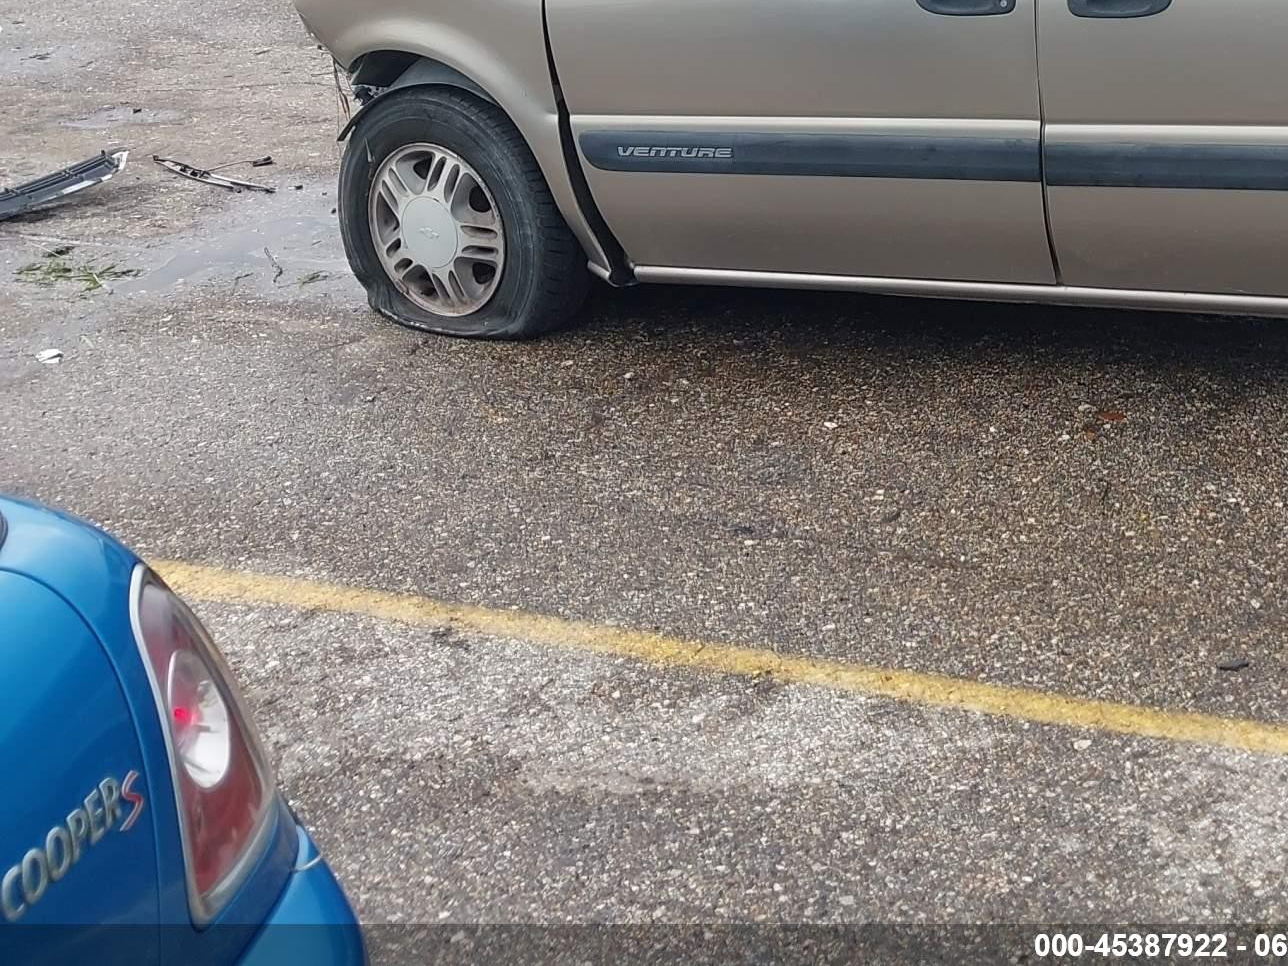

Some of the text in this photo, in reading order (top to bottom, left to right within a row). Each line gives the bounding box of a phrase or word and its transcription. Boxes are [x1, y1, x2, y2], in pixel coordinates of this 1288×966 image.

[617, 146, 733, 158] VENTURE
[1, 770, 144, 922] COOPER S
